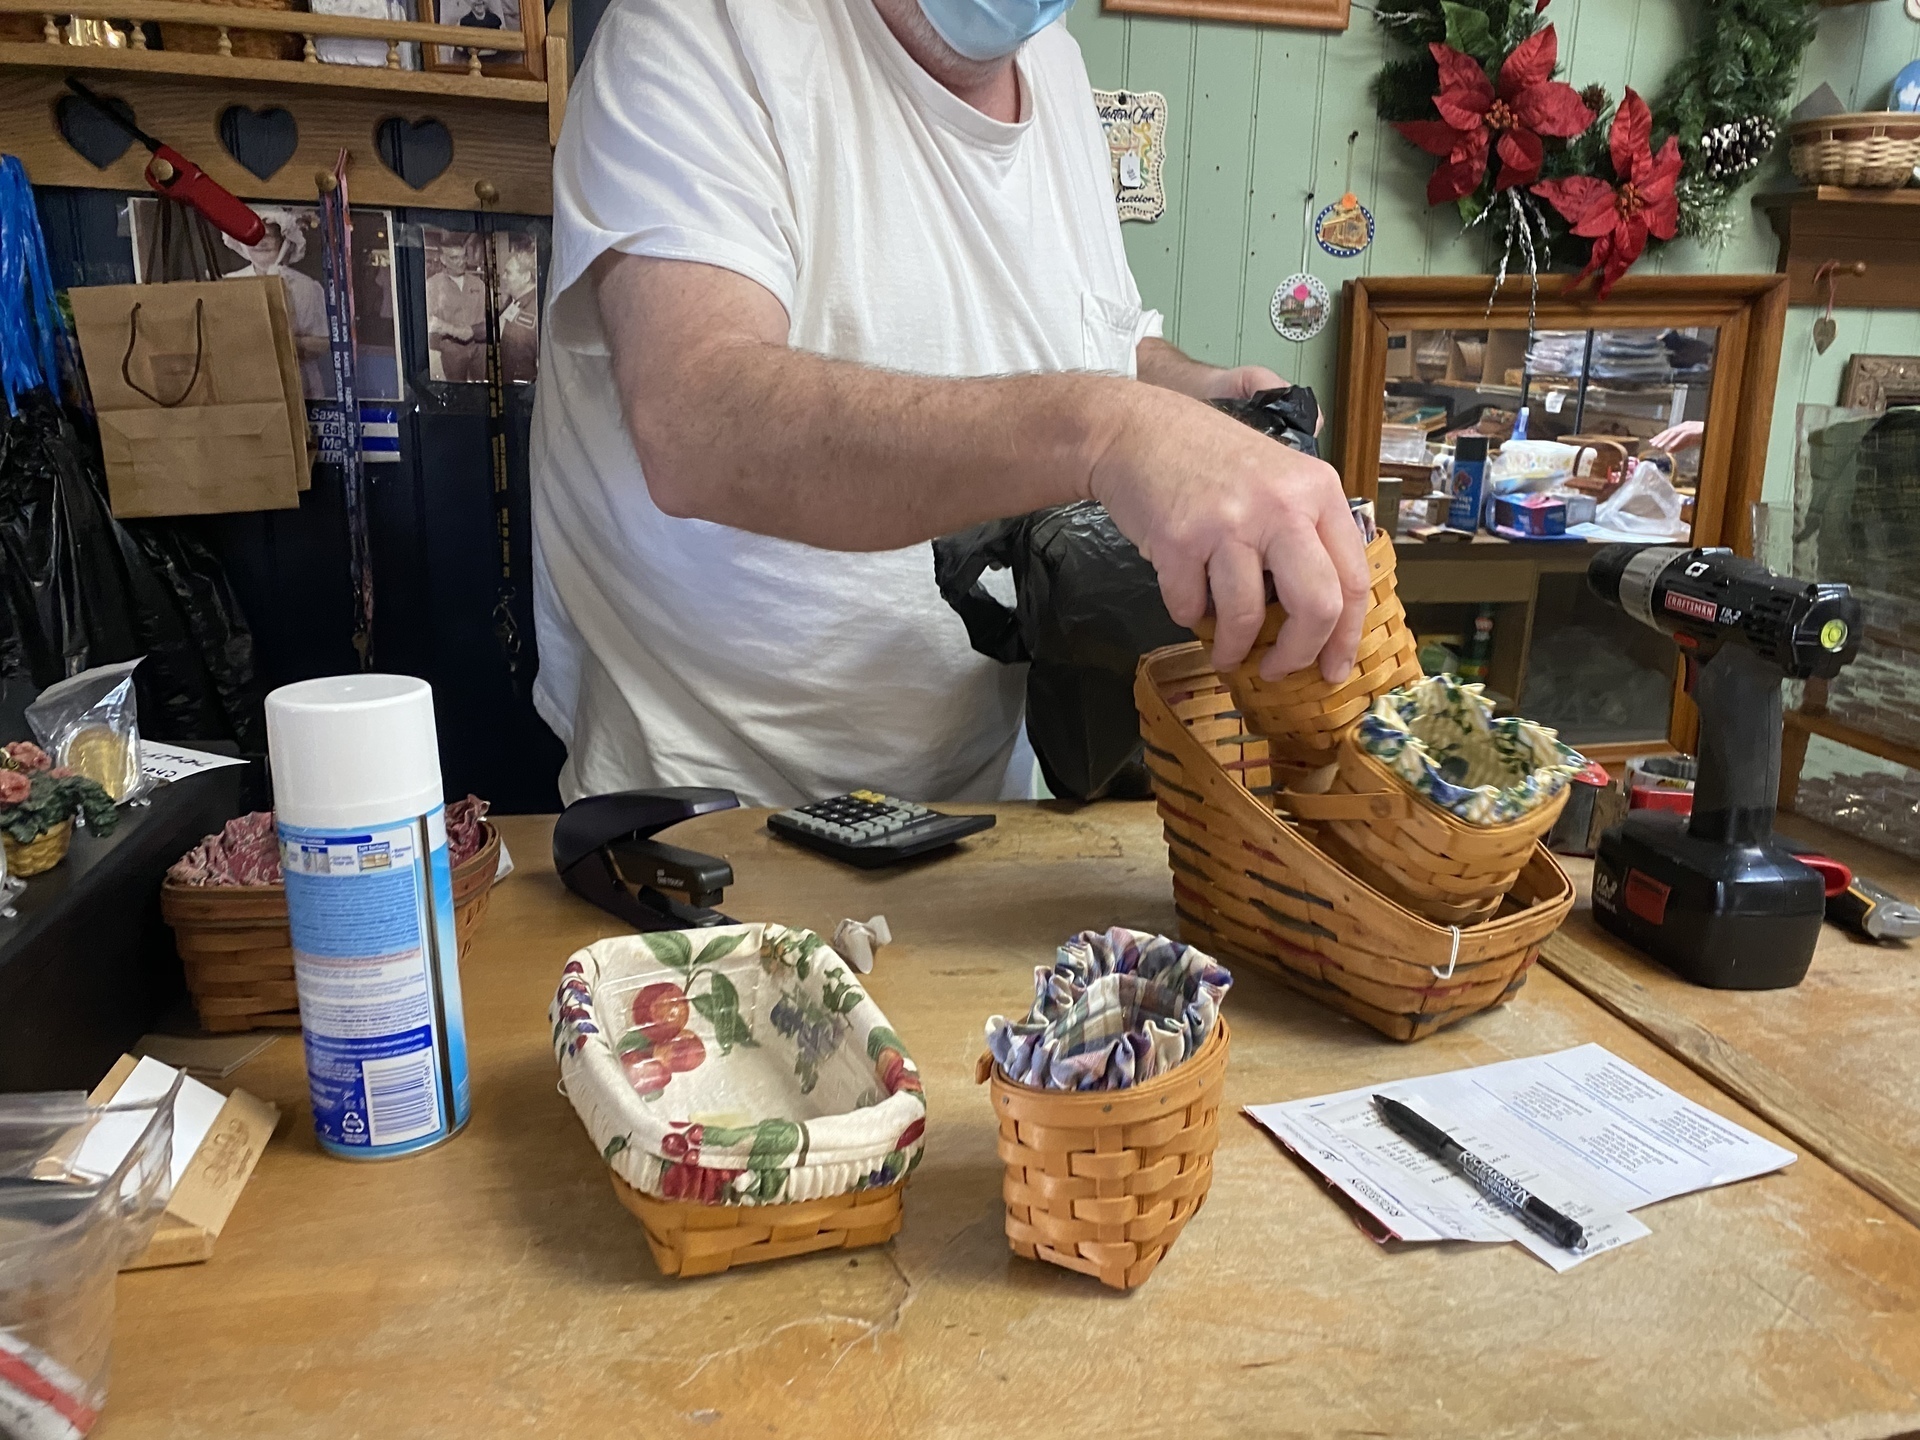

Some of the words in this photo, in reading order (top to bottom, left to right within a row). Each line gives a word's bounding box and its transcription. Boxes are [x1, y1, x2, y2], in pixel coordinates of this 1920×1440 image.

[1115, 192, 1156, 204] bration
[309, 408, 340, 421] Says
[1666, 594, 1715, 618] CRAFTSMAN
[1458, 1150, 1533, 1208] RICHARDSON
